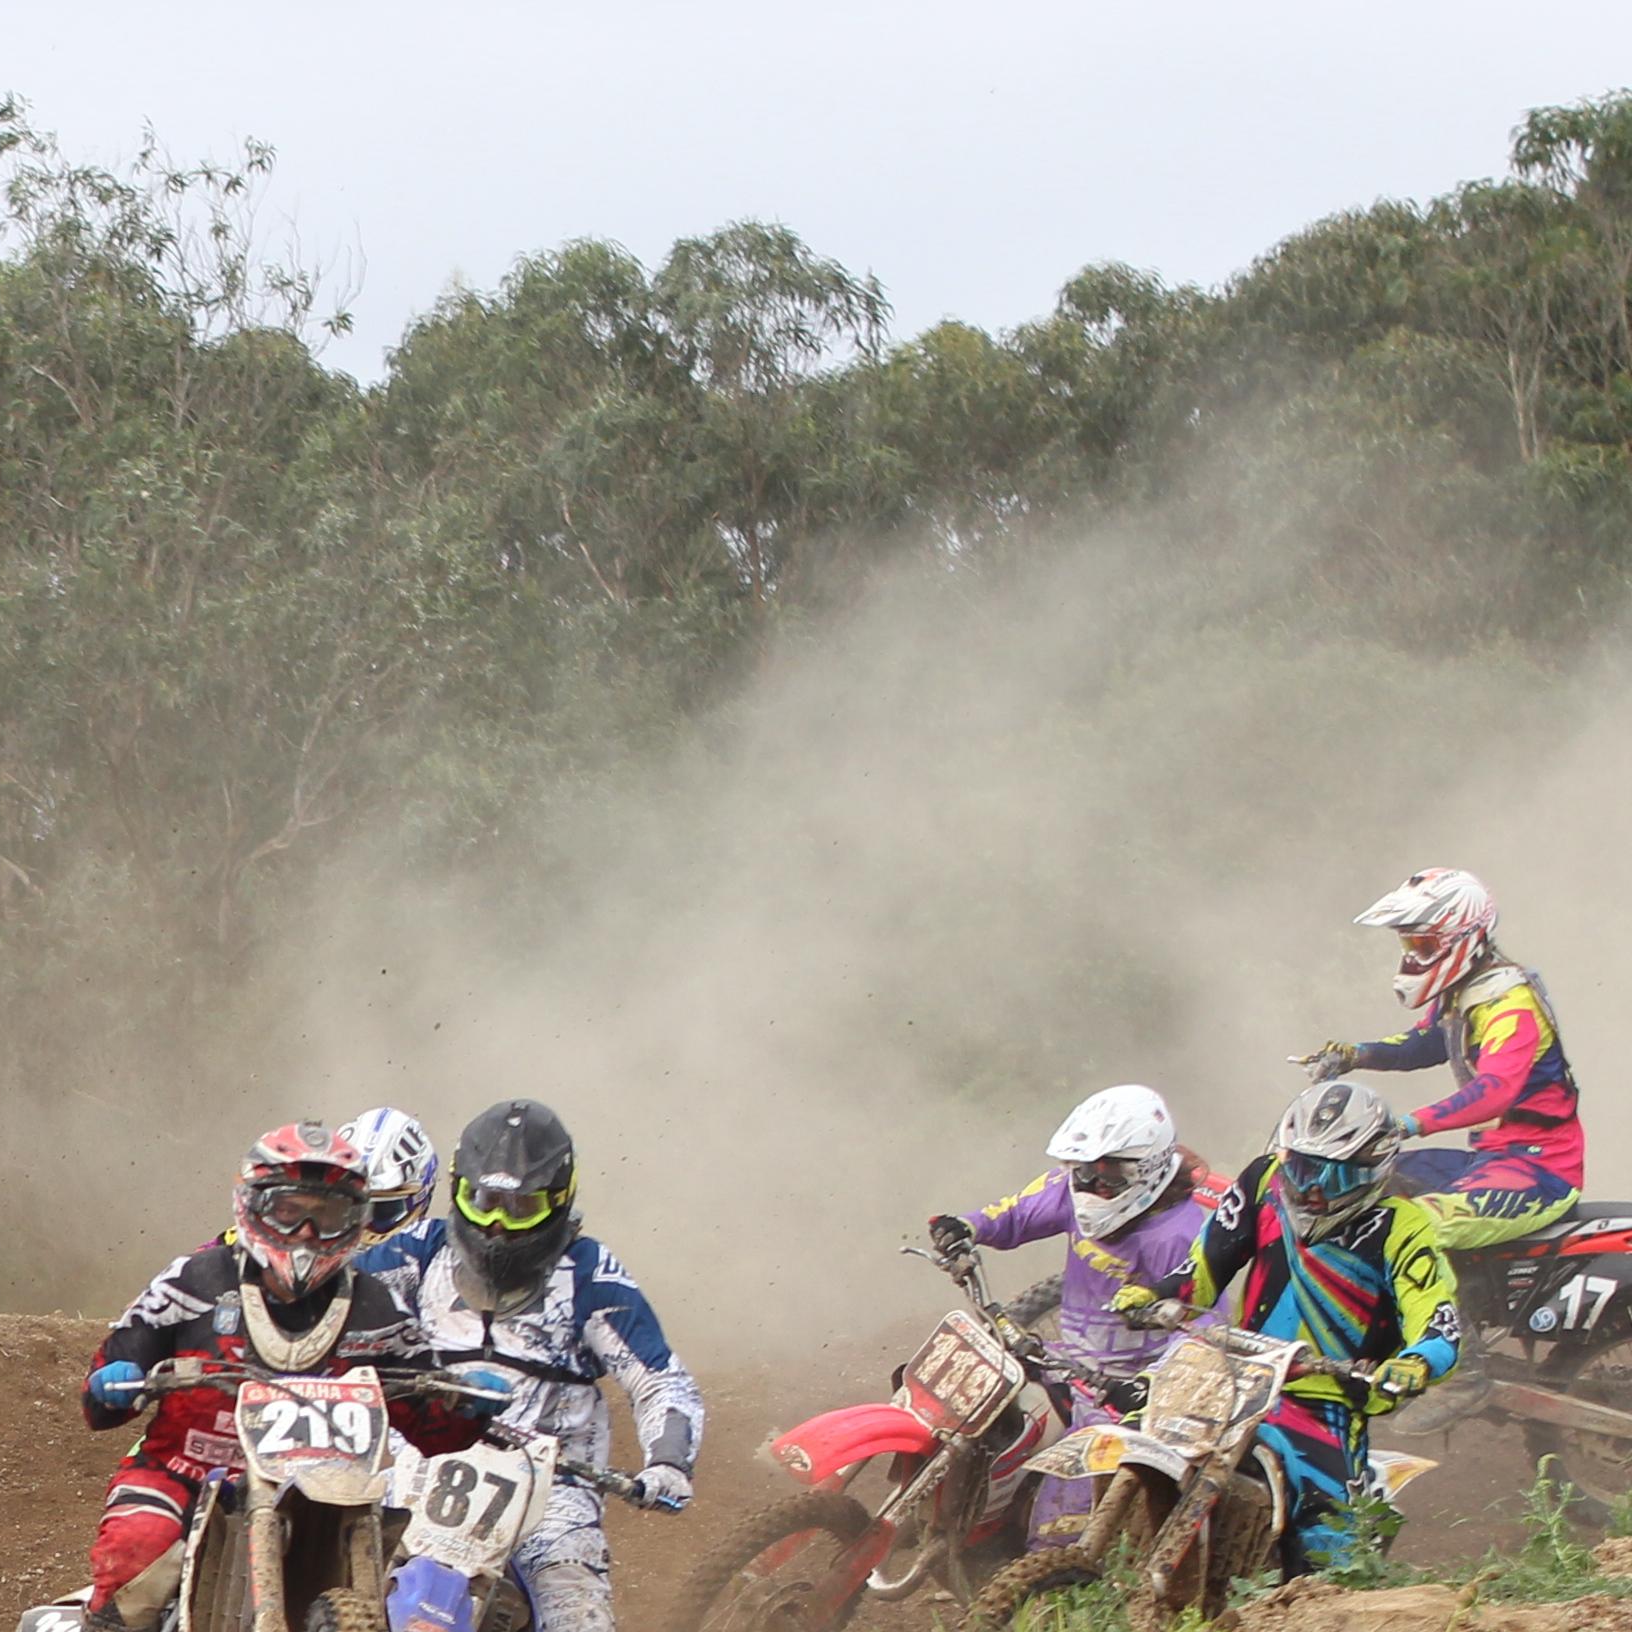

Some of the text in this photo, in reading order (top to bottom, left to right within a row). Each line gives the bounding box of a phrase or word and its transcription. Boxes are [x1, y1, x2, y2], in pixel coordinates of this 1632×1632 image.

[1559, 1274, 1618, 1329] 17
[257, 1400, 372, 1454] 219
[425, 1459, 519, 1541] 87
